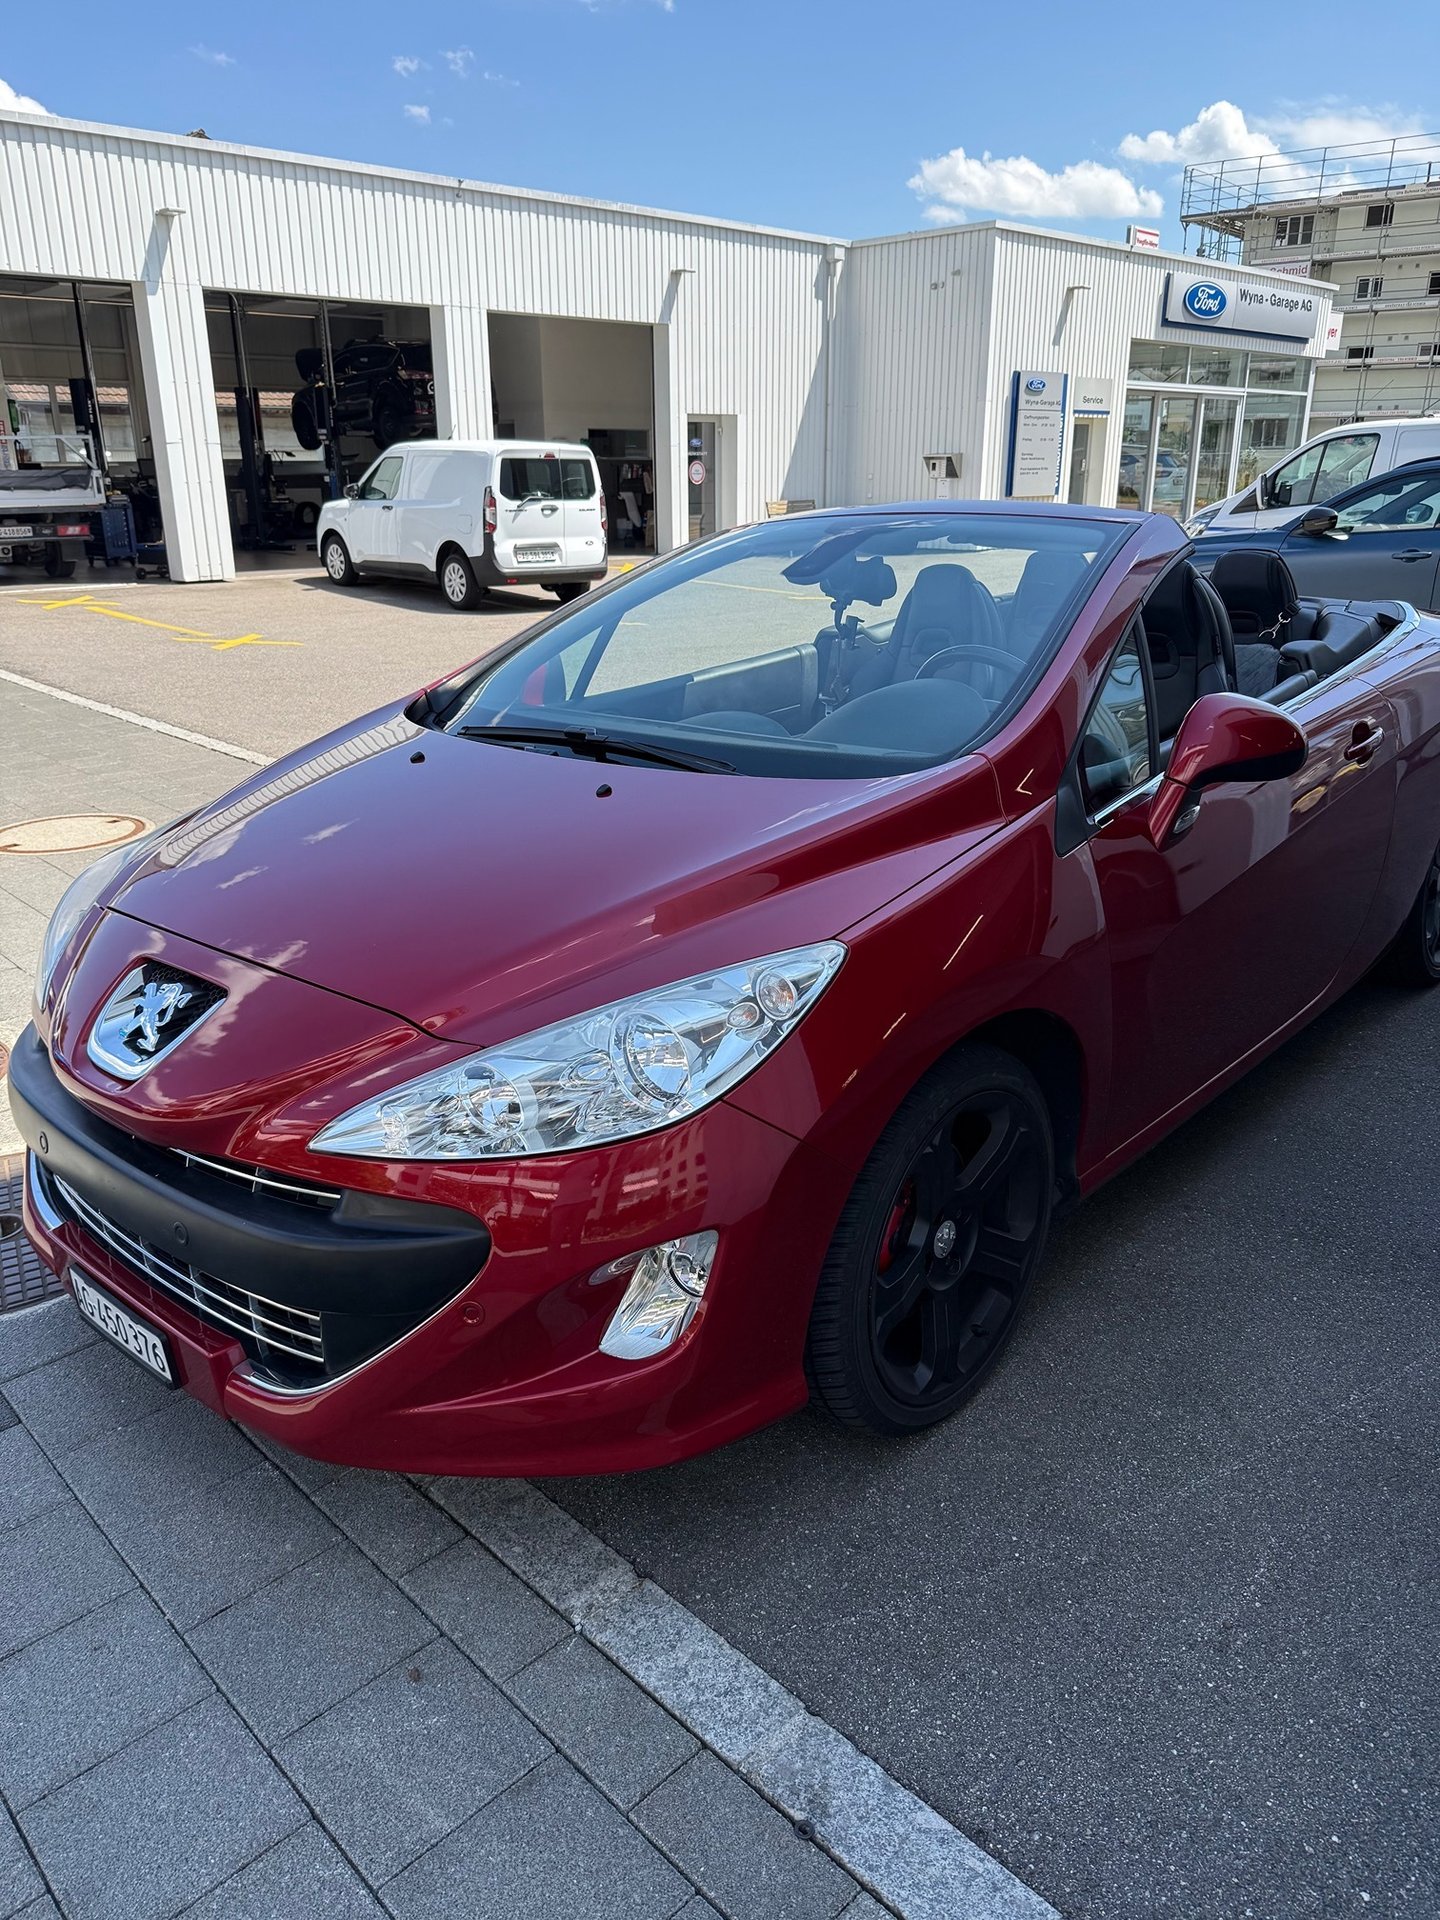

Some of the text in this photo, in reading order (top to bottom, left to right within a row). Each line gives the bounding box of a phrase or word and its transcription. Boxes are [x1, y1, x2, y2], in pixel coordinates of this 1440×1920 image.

[1194, 286, 1220, 312] Ford
[1240, 288, 1264, 305] Wyna
[1270, 293, 1299, 312] Garage
[1300, 299, 1312, 312] AG
[1083, 396, 1103, 404] Service
